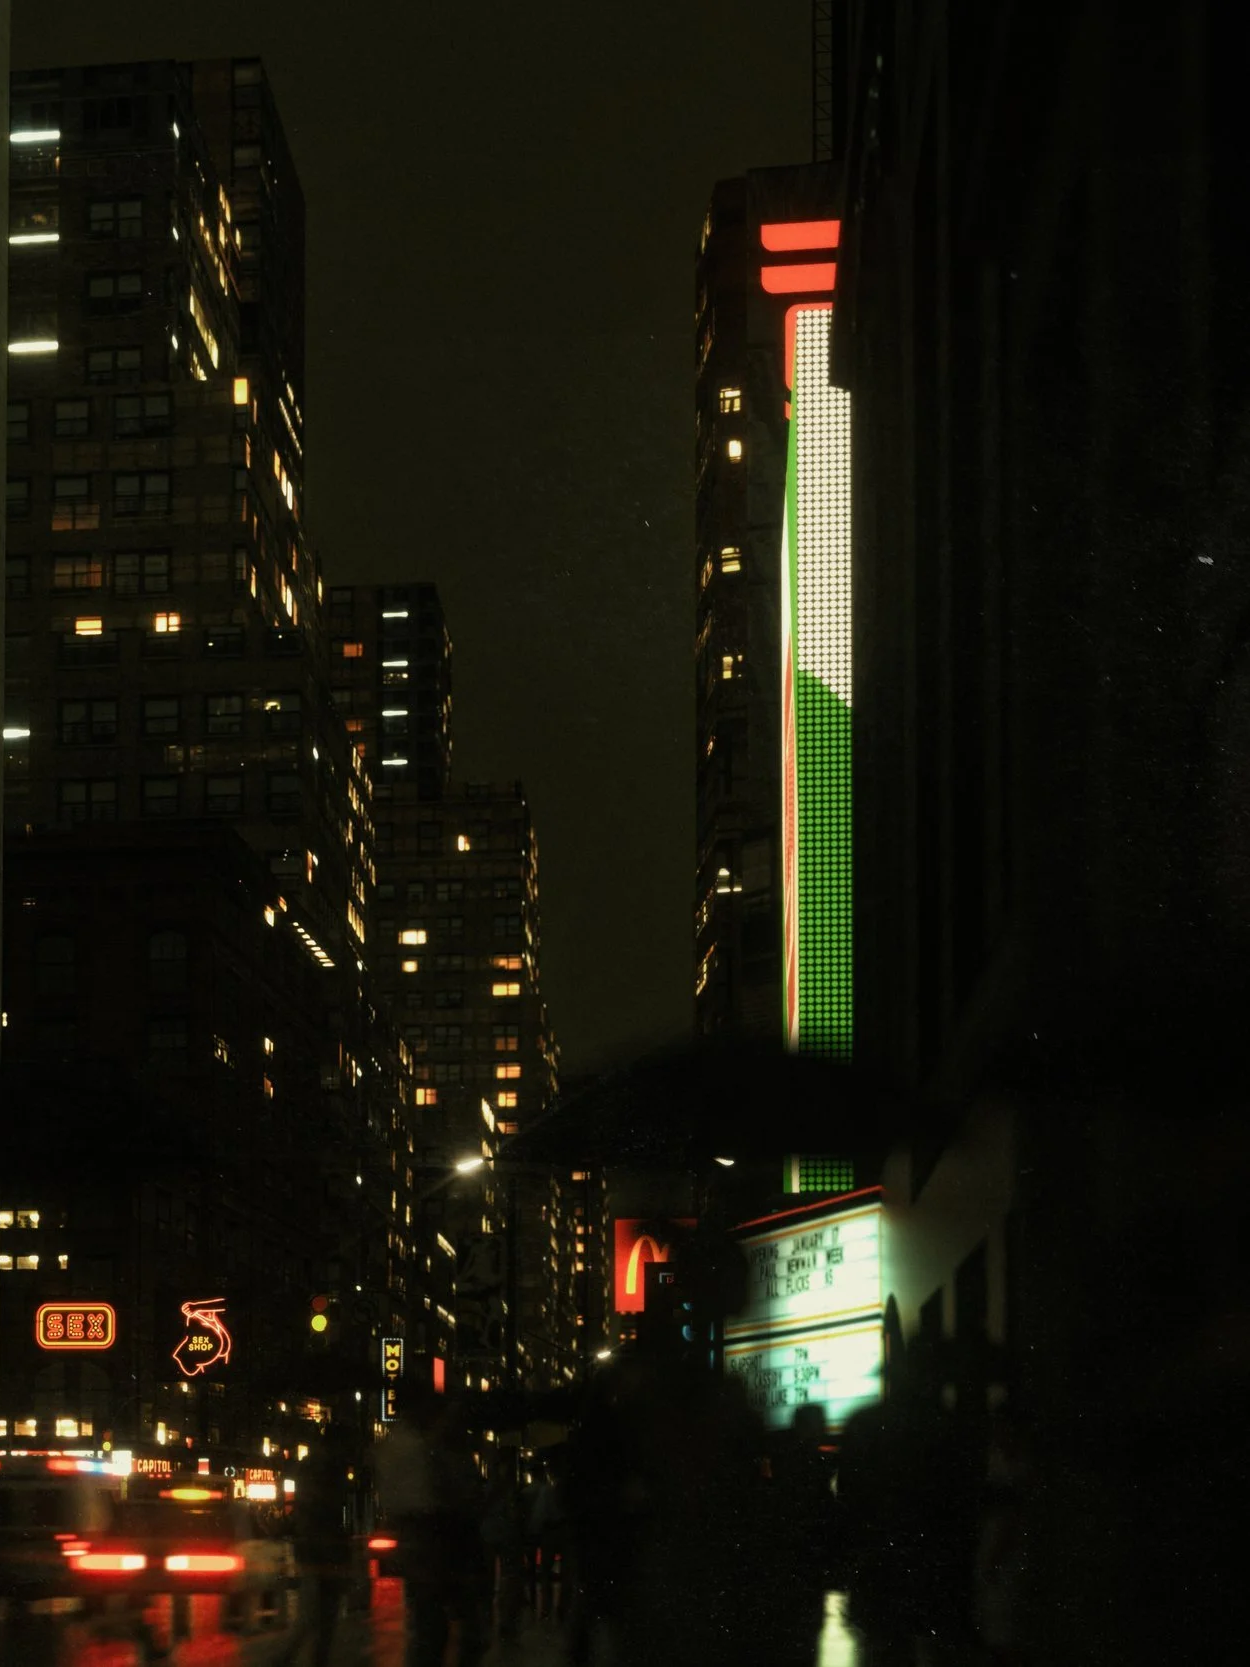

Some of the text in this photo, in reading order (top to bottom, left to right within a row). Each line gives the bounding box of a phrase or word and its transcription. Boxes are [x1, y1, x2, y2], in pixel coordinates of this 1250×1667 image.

[47, 1314, 104, 1339] SEX
[192, 1336, 210, 1344] SEX
[188, 1343, 214, 1351] SHOP
[137, 1459, 172, 1472] CAPITOL
[249, 1468, 275, 1481] CAPITOL
